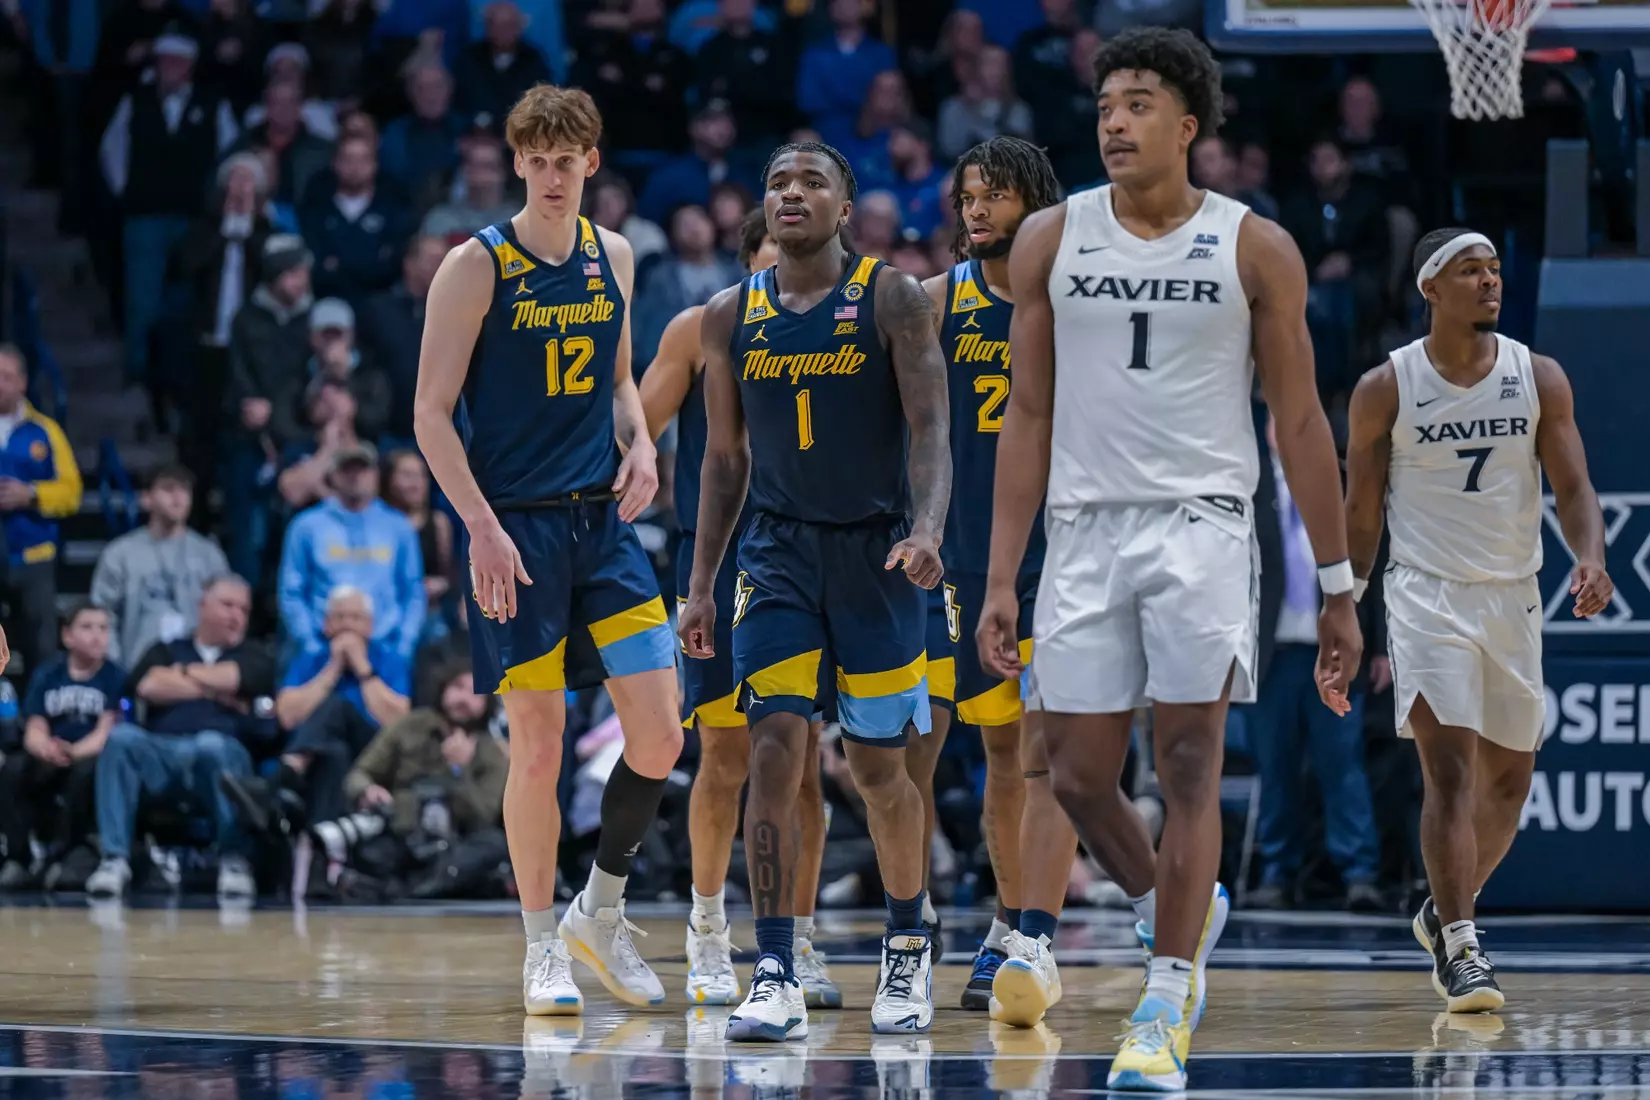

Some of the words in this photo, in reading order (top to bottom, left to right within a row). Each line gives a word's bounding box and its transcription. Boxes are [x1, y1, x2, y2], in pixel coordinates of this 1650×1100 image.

[512, 294, 614, 333] Marquette
[1066, 275, 1221, 303] XAVIER
[545, 336, 595, 396] 12
[743, 344, 866, 384] Marquette
[1127, 312, 1150, 370] 1
[796, 389, 814, 450] 1
[973, 375, 1009, 432] 2
[1414, 417, 1528, 443] XAVIER
[1454, 446, 1494, 492] 7
[1543, 682, 1650, 744] SE
[1518, 771, 1650, 832] AUT
